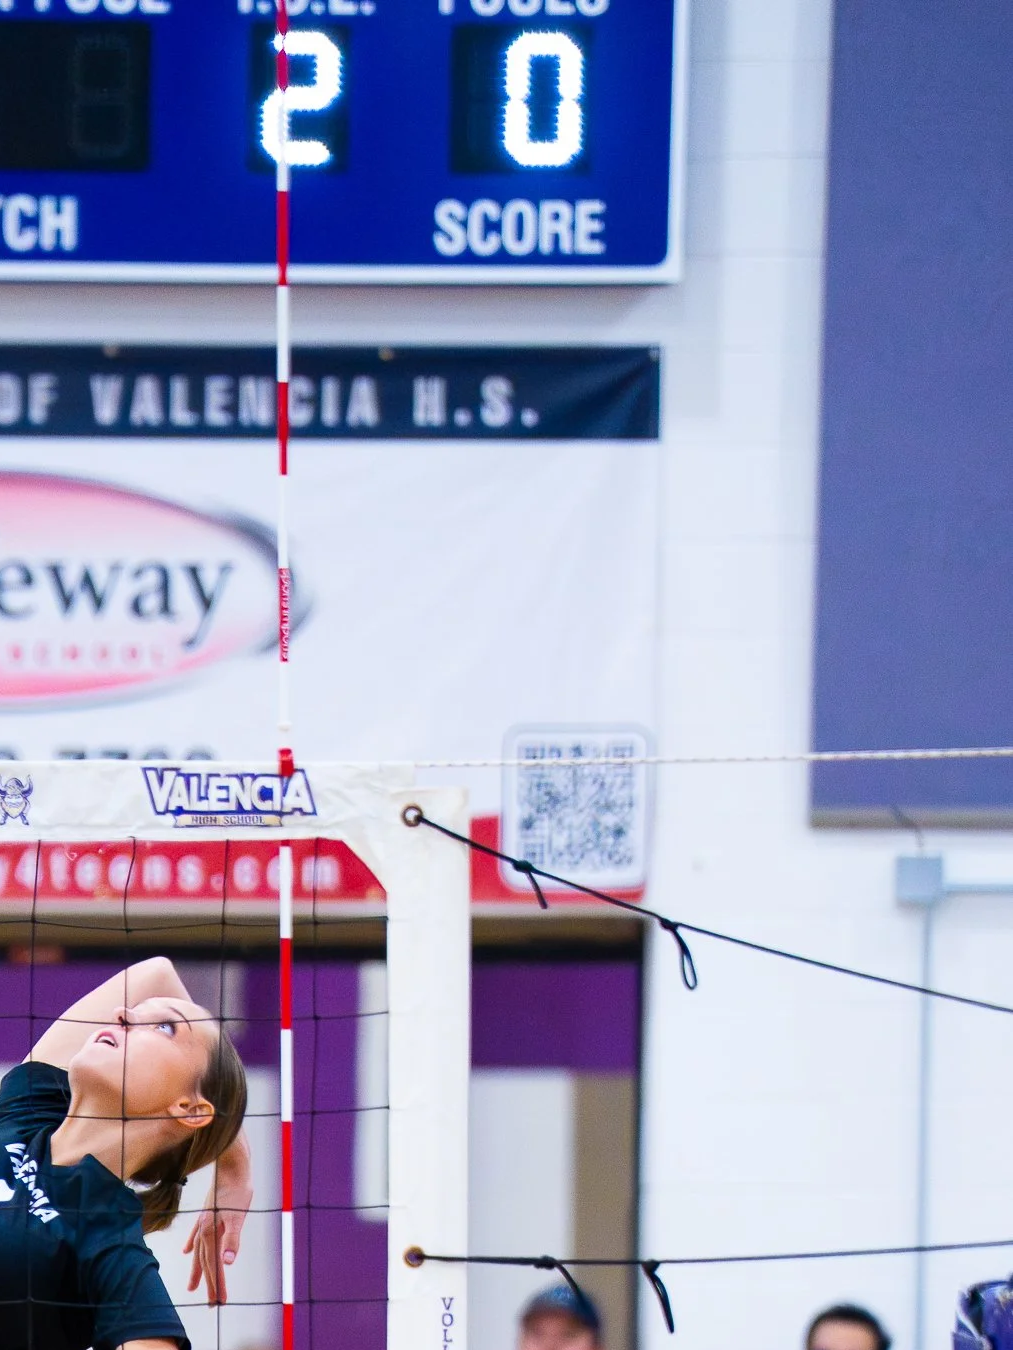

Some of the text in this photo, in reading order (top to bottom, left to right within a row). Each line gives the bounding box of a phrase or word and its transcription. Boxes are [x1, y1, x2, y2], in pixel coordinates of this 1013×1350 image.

[260, 30, 343, 166] 2
[502, 31, 585, 167] 0
[432, 199, 607, 256] SCORE
[89, 374, 380, 428] VALENCIA
[412, 377, 541, 428] H.S.
[141, 767, 318, 816] VALENCIA
[191, 816, 266, 826] HIGH SCHOOL
